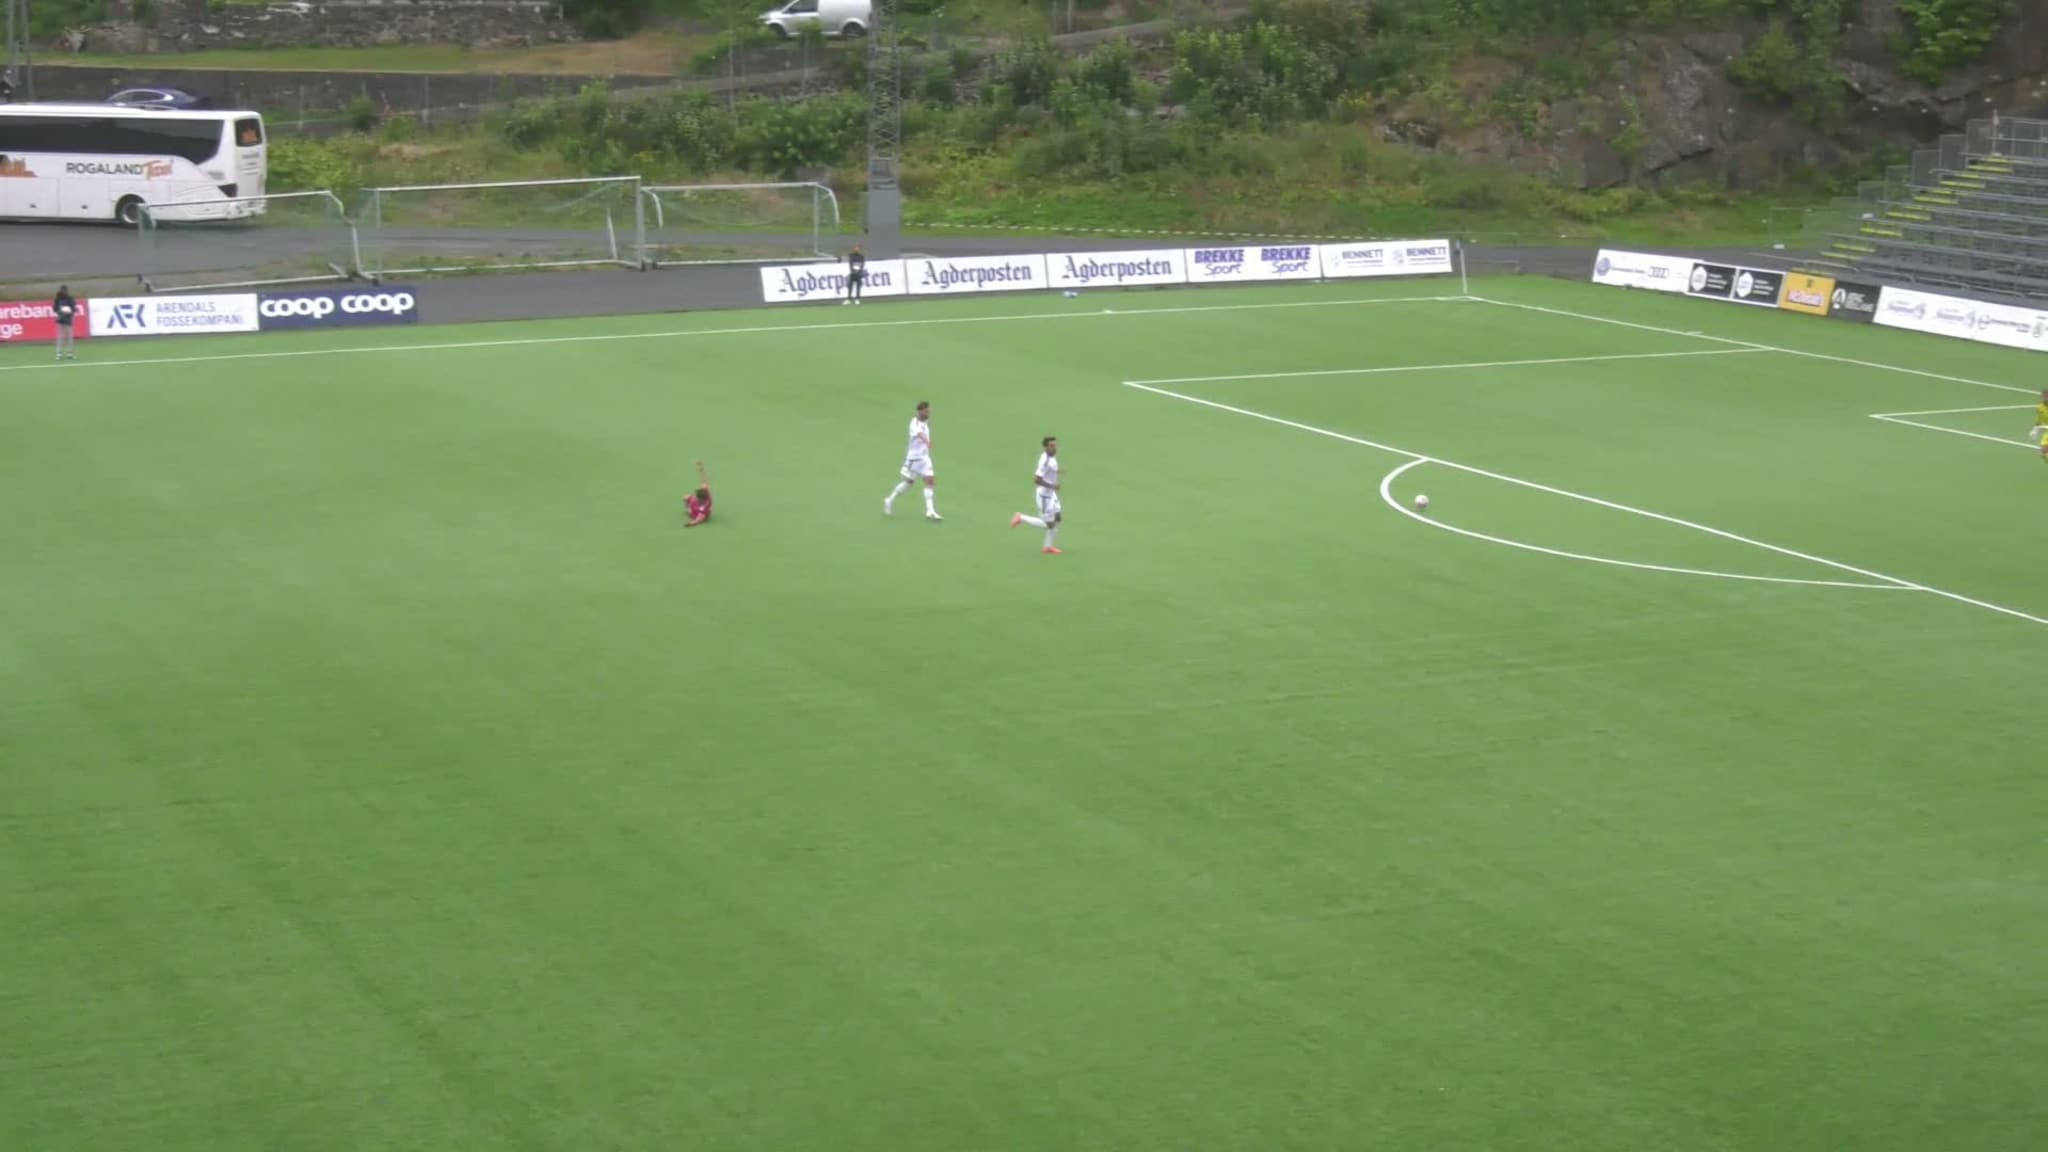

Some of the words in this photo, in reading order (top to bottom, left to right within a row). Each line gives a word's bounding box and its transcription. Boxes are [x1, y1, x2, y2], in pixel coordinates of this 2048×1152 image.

[65, 162, 144, 175] ROGALAND
[1195, 249, 1245, 264] BREKKE
[1261, 247, 1311, 261] BREKKE
[1342, 249, 1383, 259] BENNETT
[1406, 247, 1447, 257] BENNETT
[922, 260, 1032, 288] Agderposten
[1062, 255, 1172, 283] Agderposten
[779, 267, 891, 297] Agderpten
[156, 302, 217, 314] ARENDALS
[260, 297, 334, 319] coop
[340, 293, 414, 315] coop
[156, 315, 243, 327] FOSSEKOMPANI
